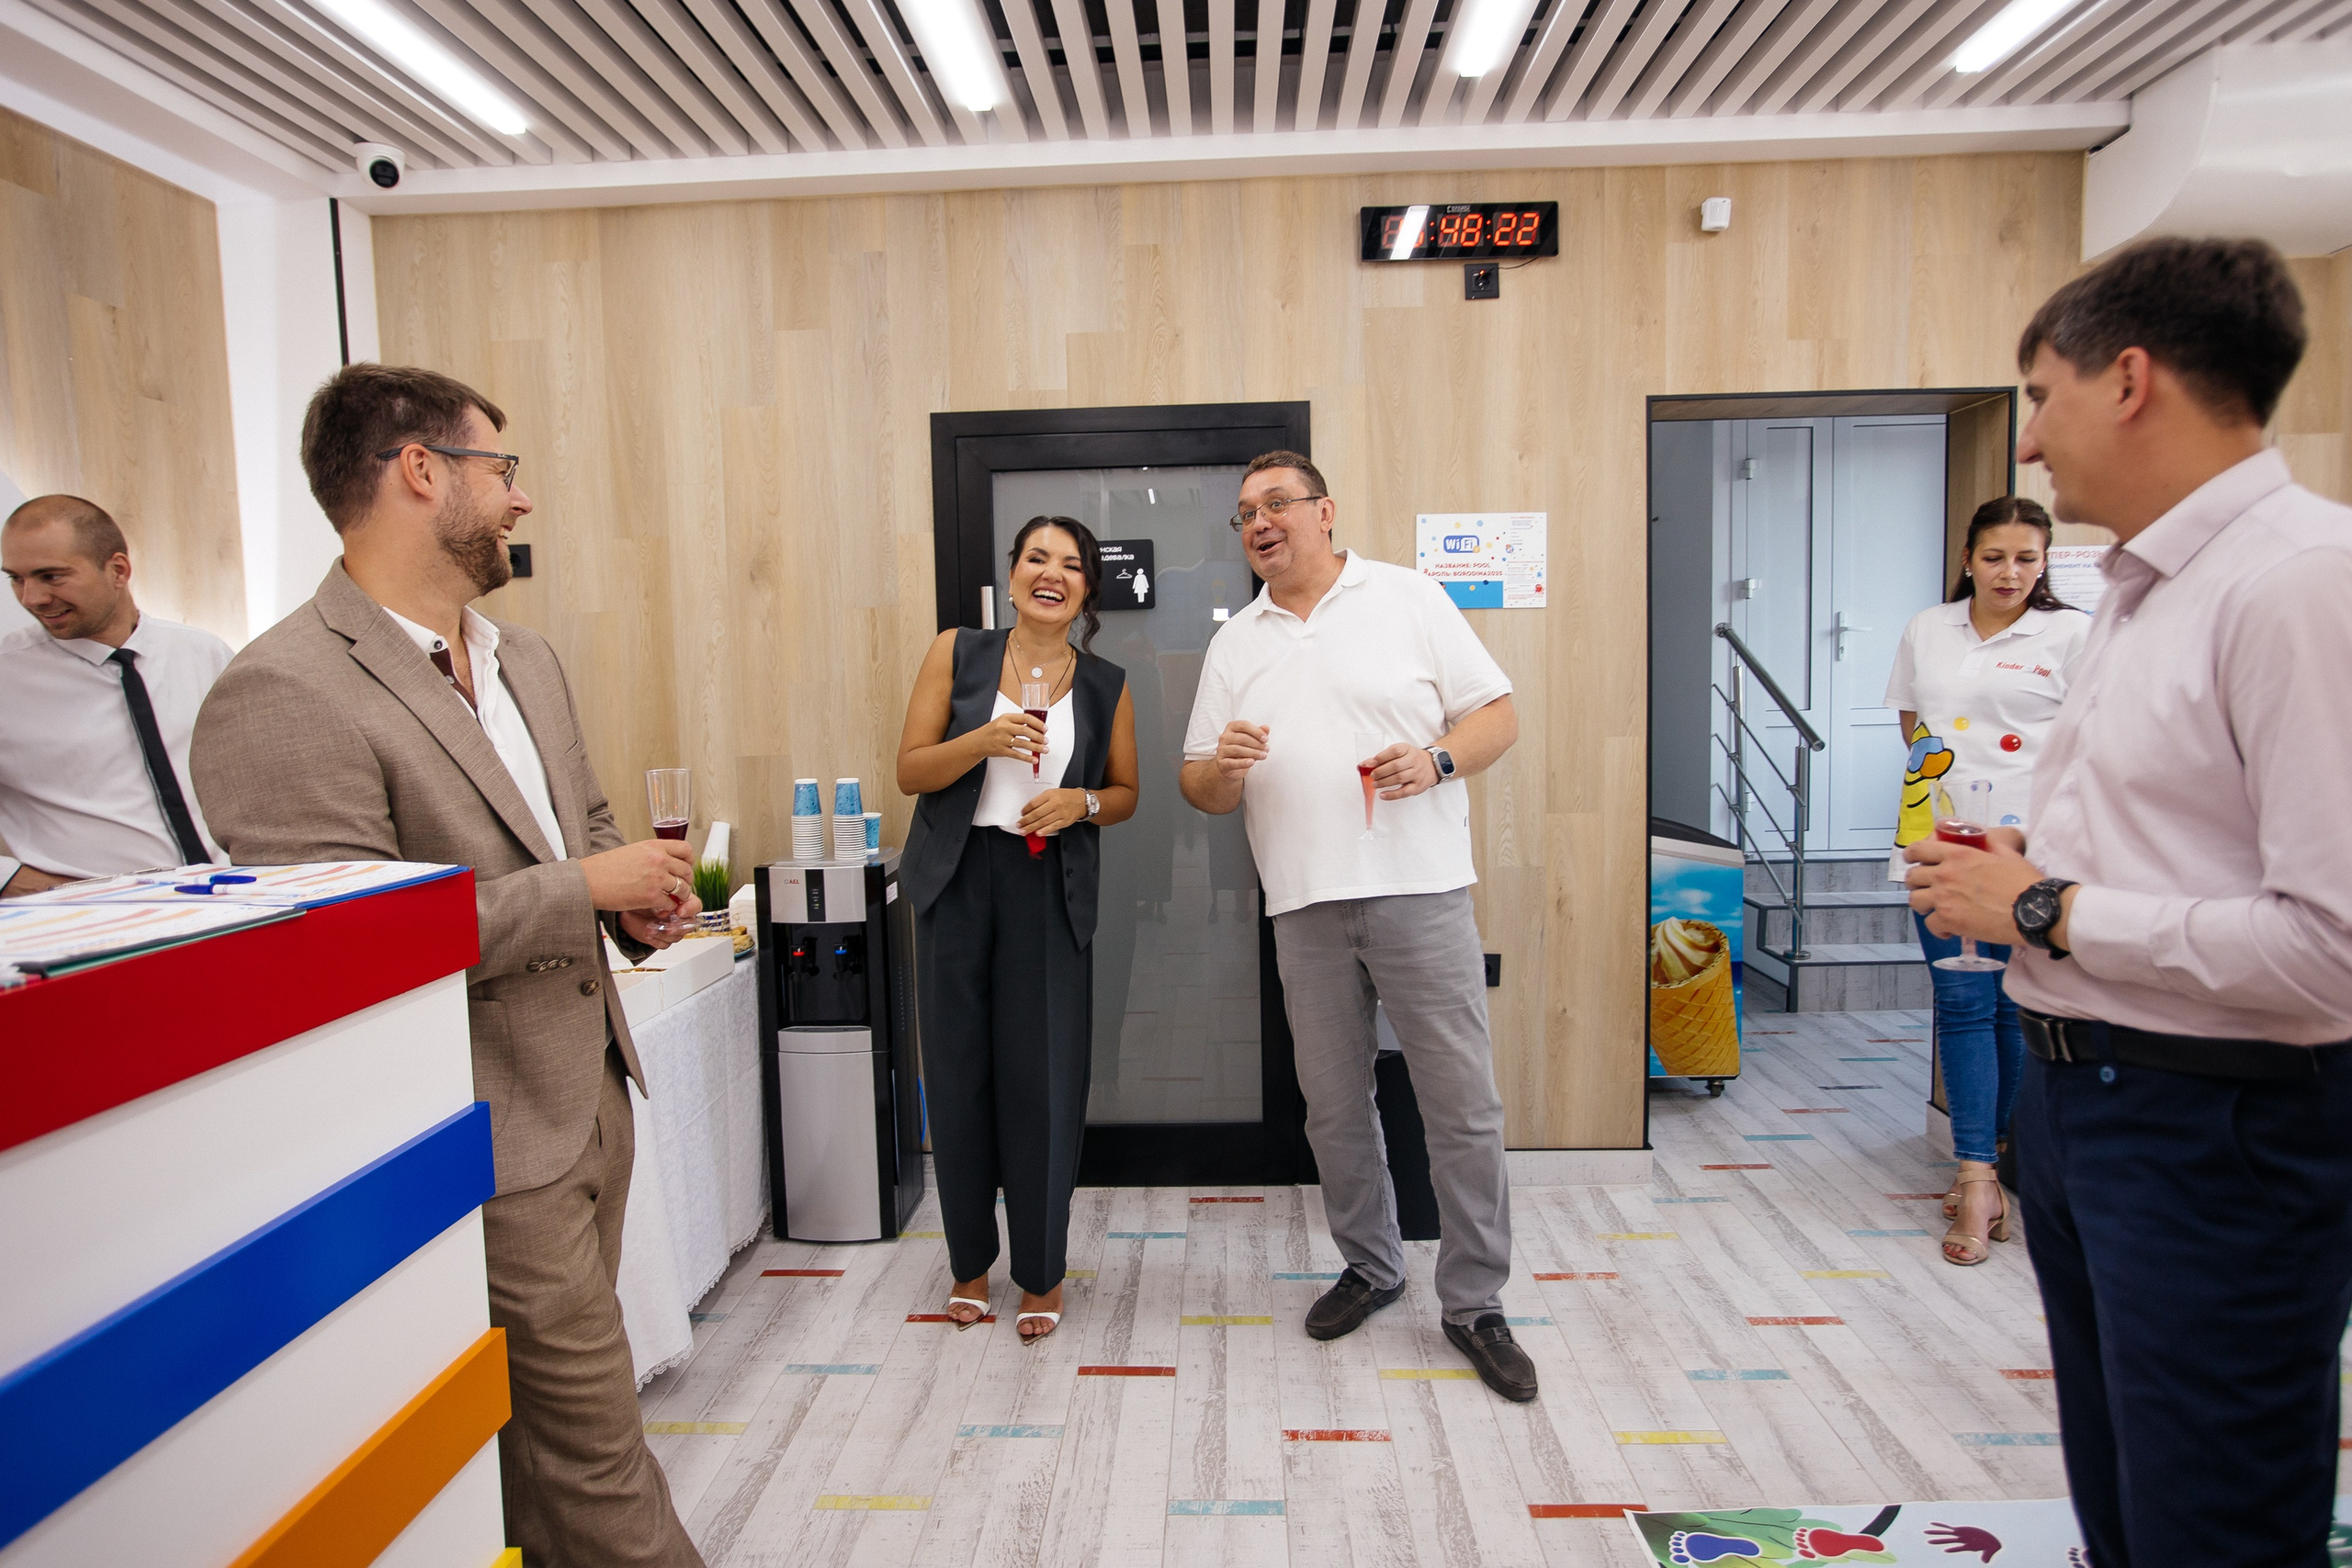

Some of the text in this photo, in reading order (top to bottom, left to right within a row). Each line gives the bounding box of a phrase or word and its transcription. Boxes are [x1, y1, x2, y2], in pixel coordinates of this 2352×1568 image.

[1382, 212, 1540, 248] :48:22
[1996, 661, 2052, 678] Kinder Pool
